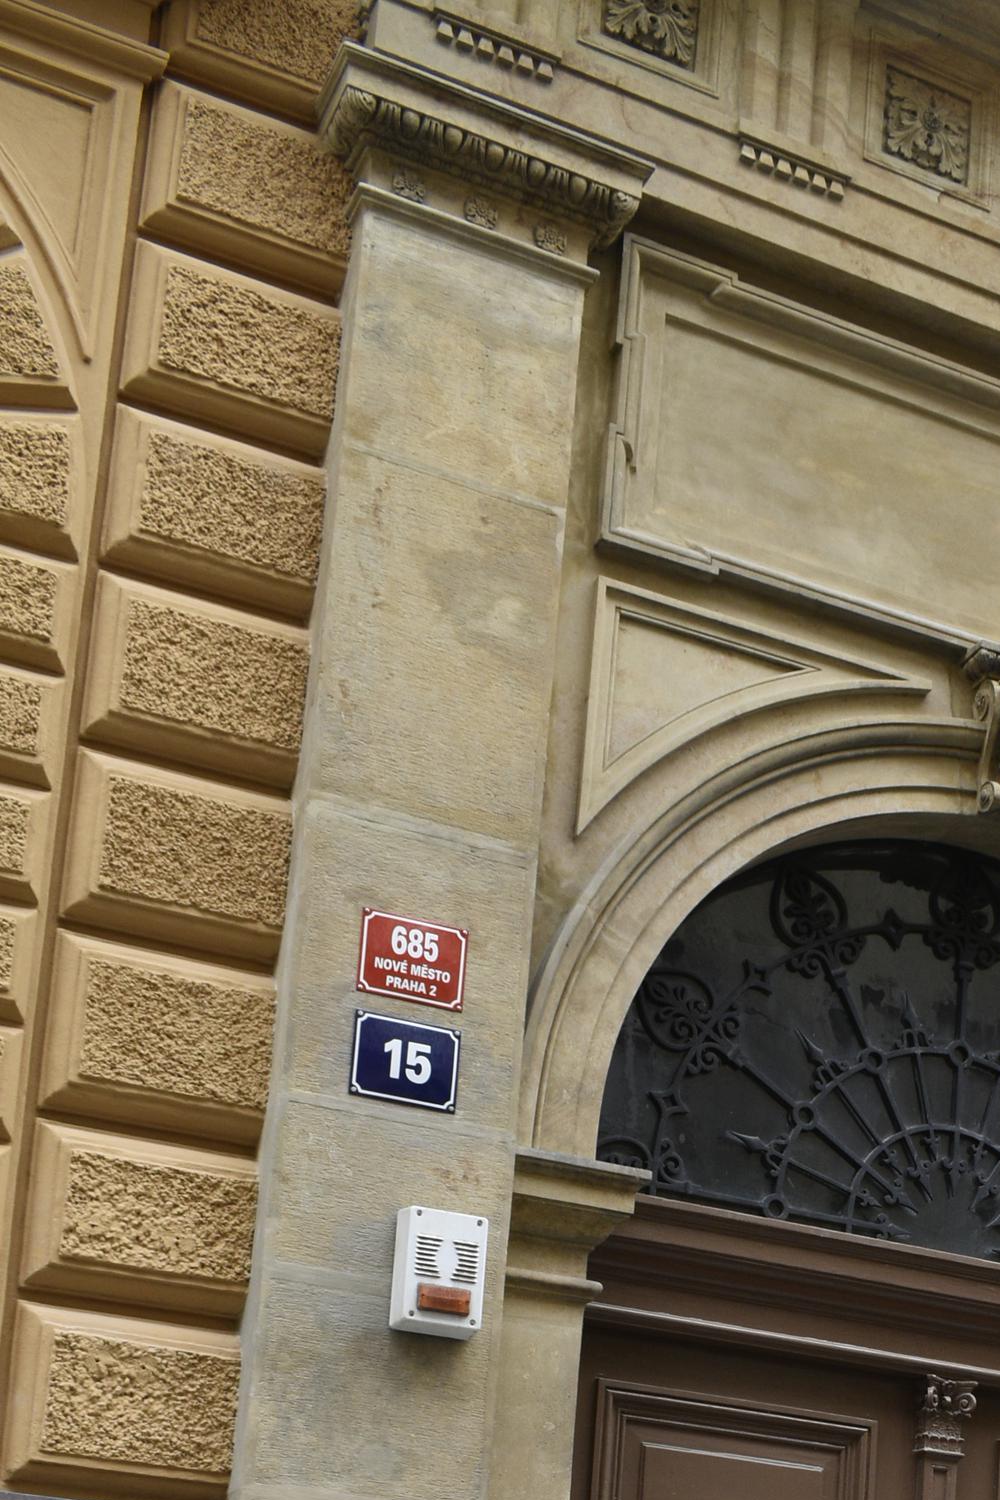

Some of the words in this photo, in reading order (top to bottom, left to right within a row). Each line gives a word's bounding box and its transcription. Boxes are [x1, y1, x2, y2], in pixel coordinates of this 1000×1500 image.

[391, 926, 439, 962] 685
[374, 957, 408, 973] NOVÉ
[410, 964, 451, 983] MĚSTO
[386, 975, 427, 995] PRAHA
[429, 985, 437, 997] 2
[384, 1038, 432, 1085] 15
